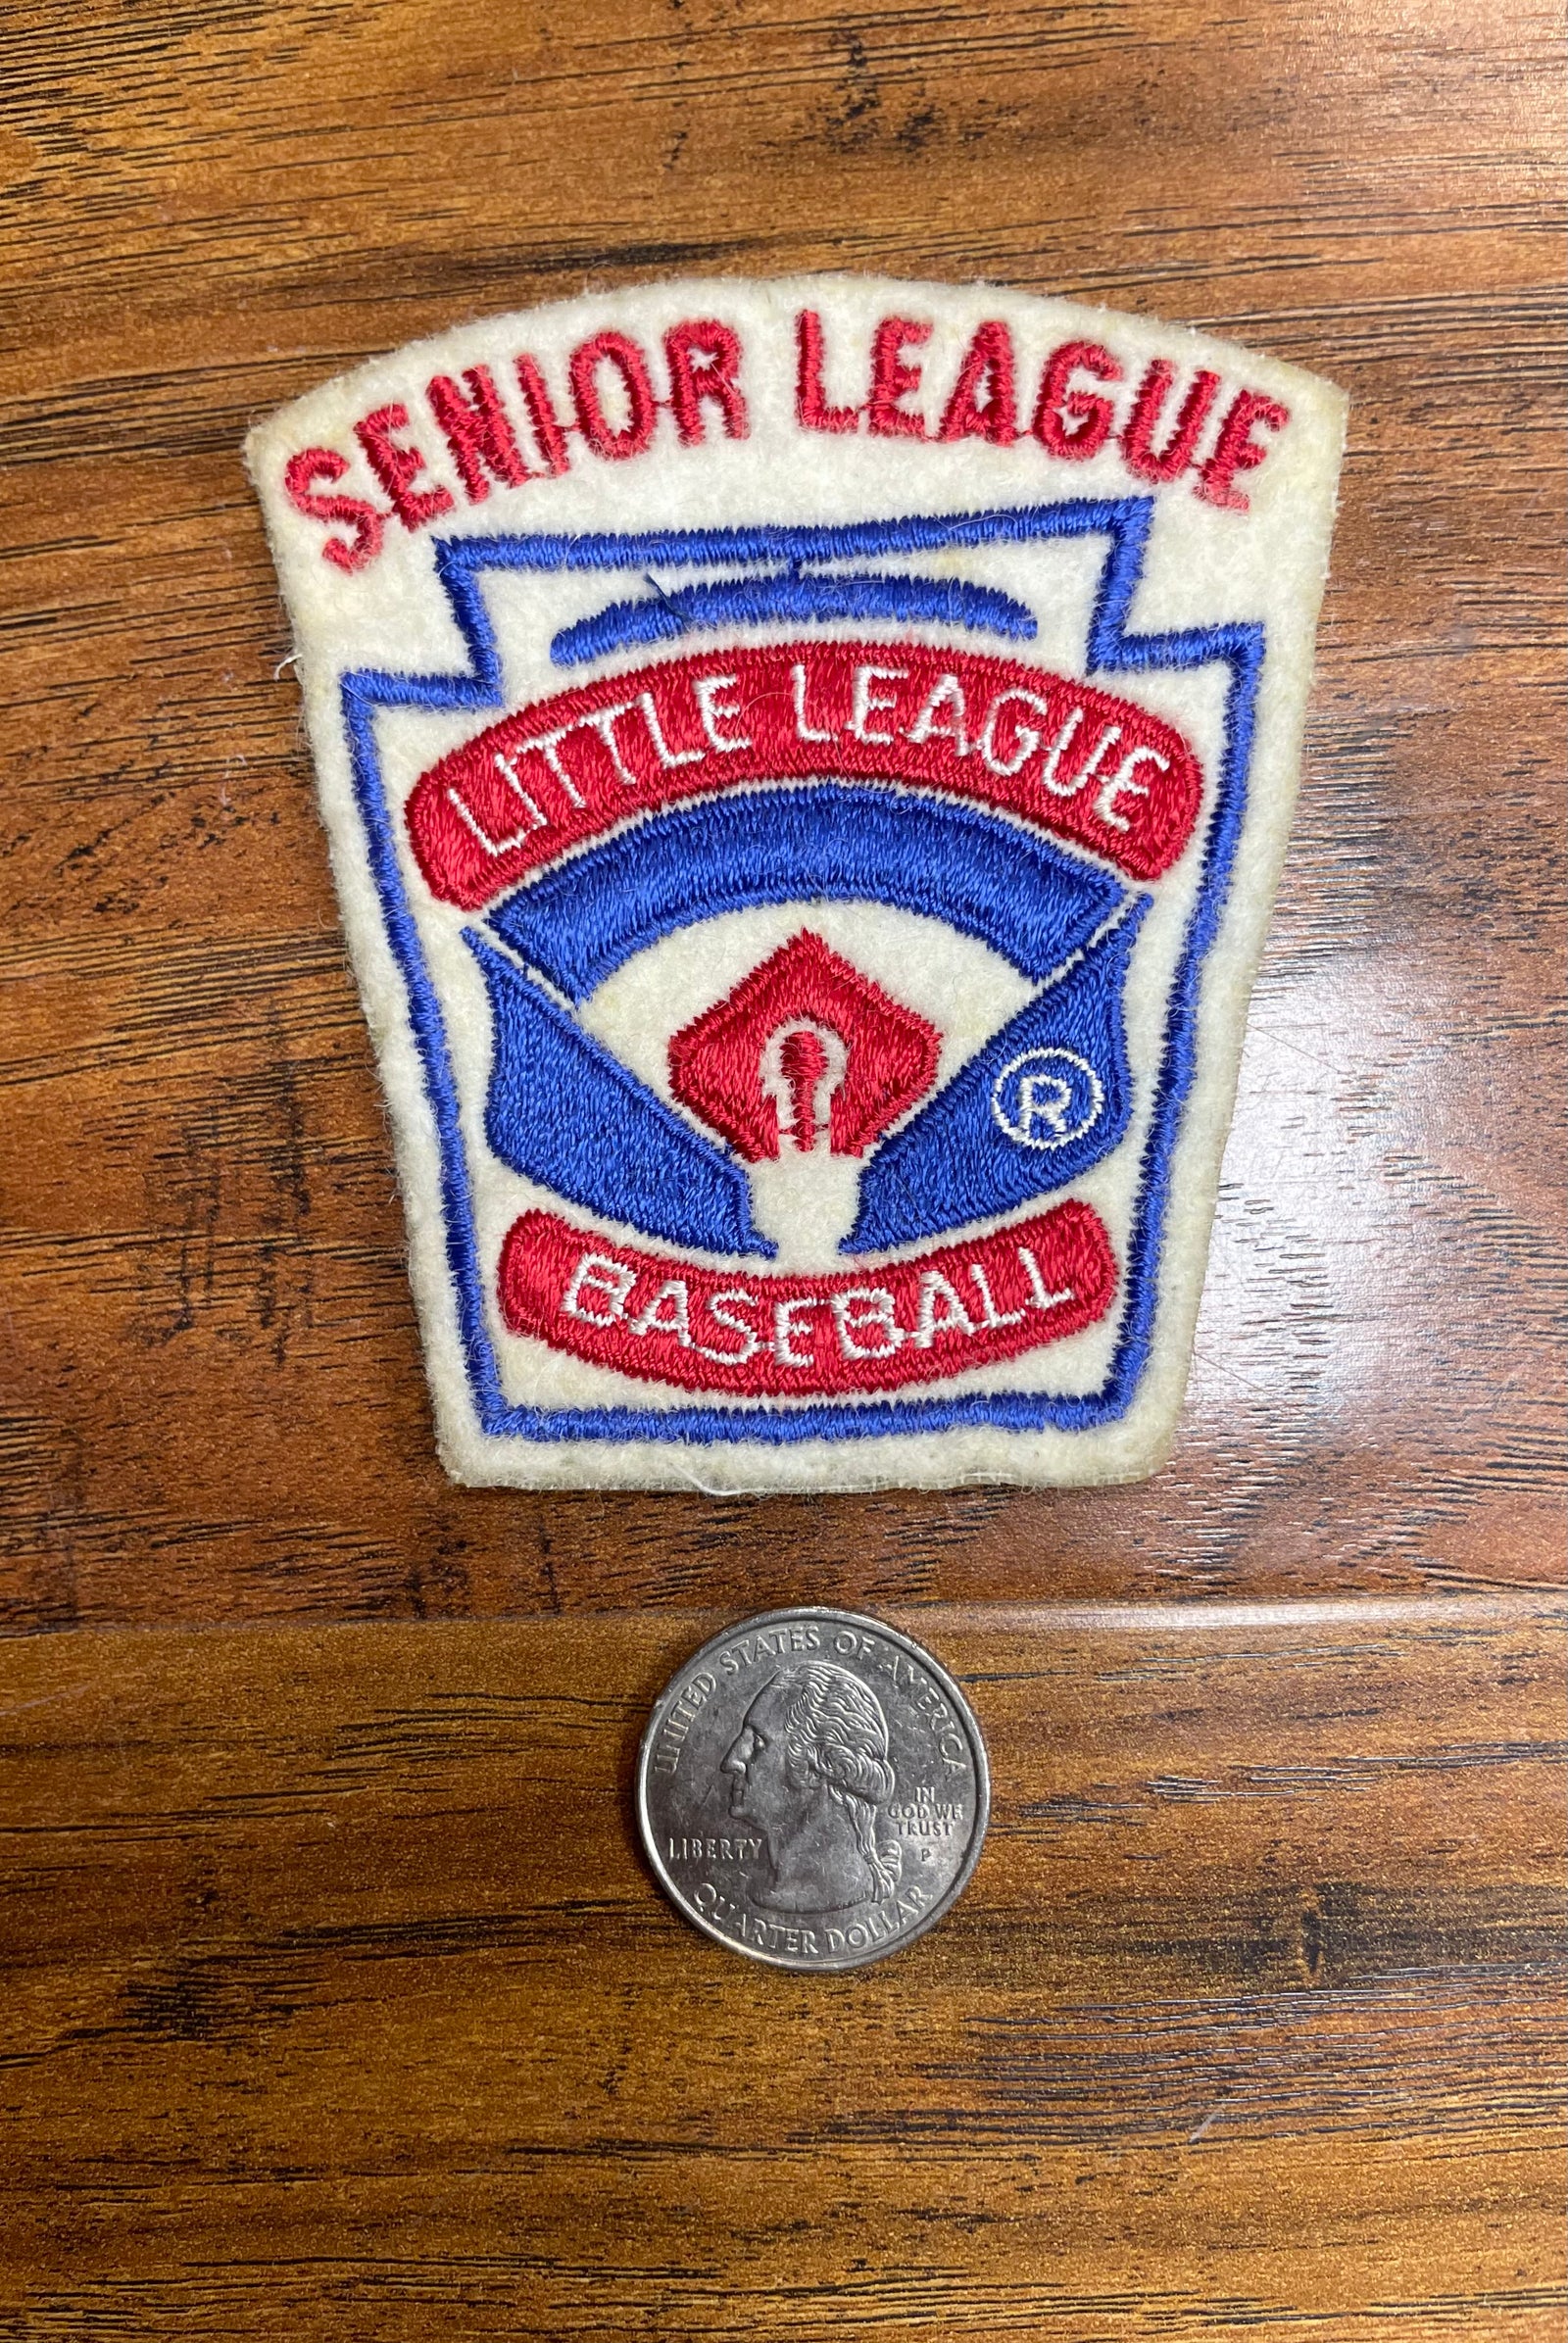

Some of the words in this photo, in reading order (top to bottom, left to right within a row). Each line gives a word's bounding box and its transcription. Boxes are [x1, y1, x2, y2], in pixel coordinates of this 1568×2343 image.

[285, 318, 749, 574] SENIOR
[796, 309, 1288, 513] LEAGUE
[449, 674, 751, 854] LITTLE
[791, 664, 1170, 831] LEAGUE
[561, 1249, 1073, 1367] BASEBALL
[655, 1672, 717, 1775] UNITED
[719, 1626, 820, 1675] STATES
[834, 1632, 875, 1659] OF
[881, 1654, 966, 1782] AMERICA
[887, 1803, 929, 1820] GOD
[932, 1803, 963, 1820] WE
[897, 1821, 955, 1836] TRUST
[914, 1786, 935, 1803] IN
[668, 1837, 763, 1861] LIBERTY
[694, 1882, 819, 1955] QUARTER
[825, 1884, 933, 1954] DOLLAR
